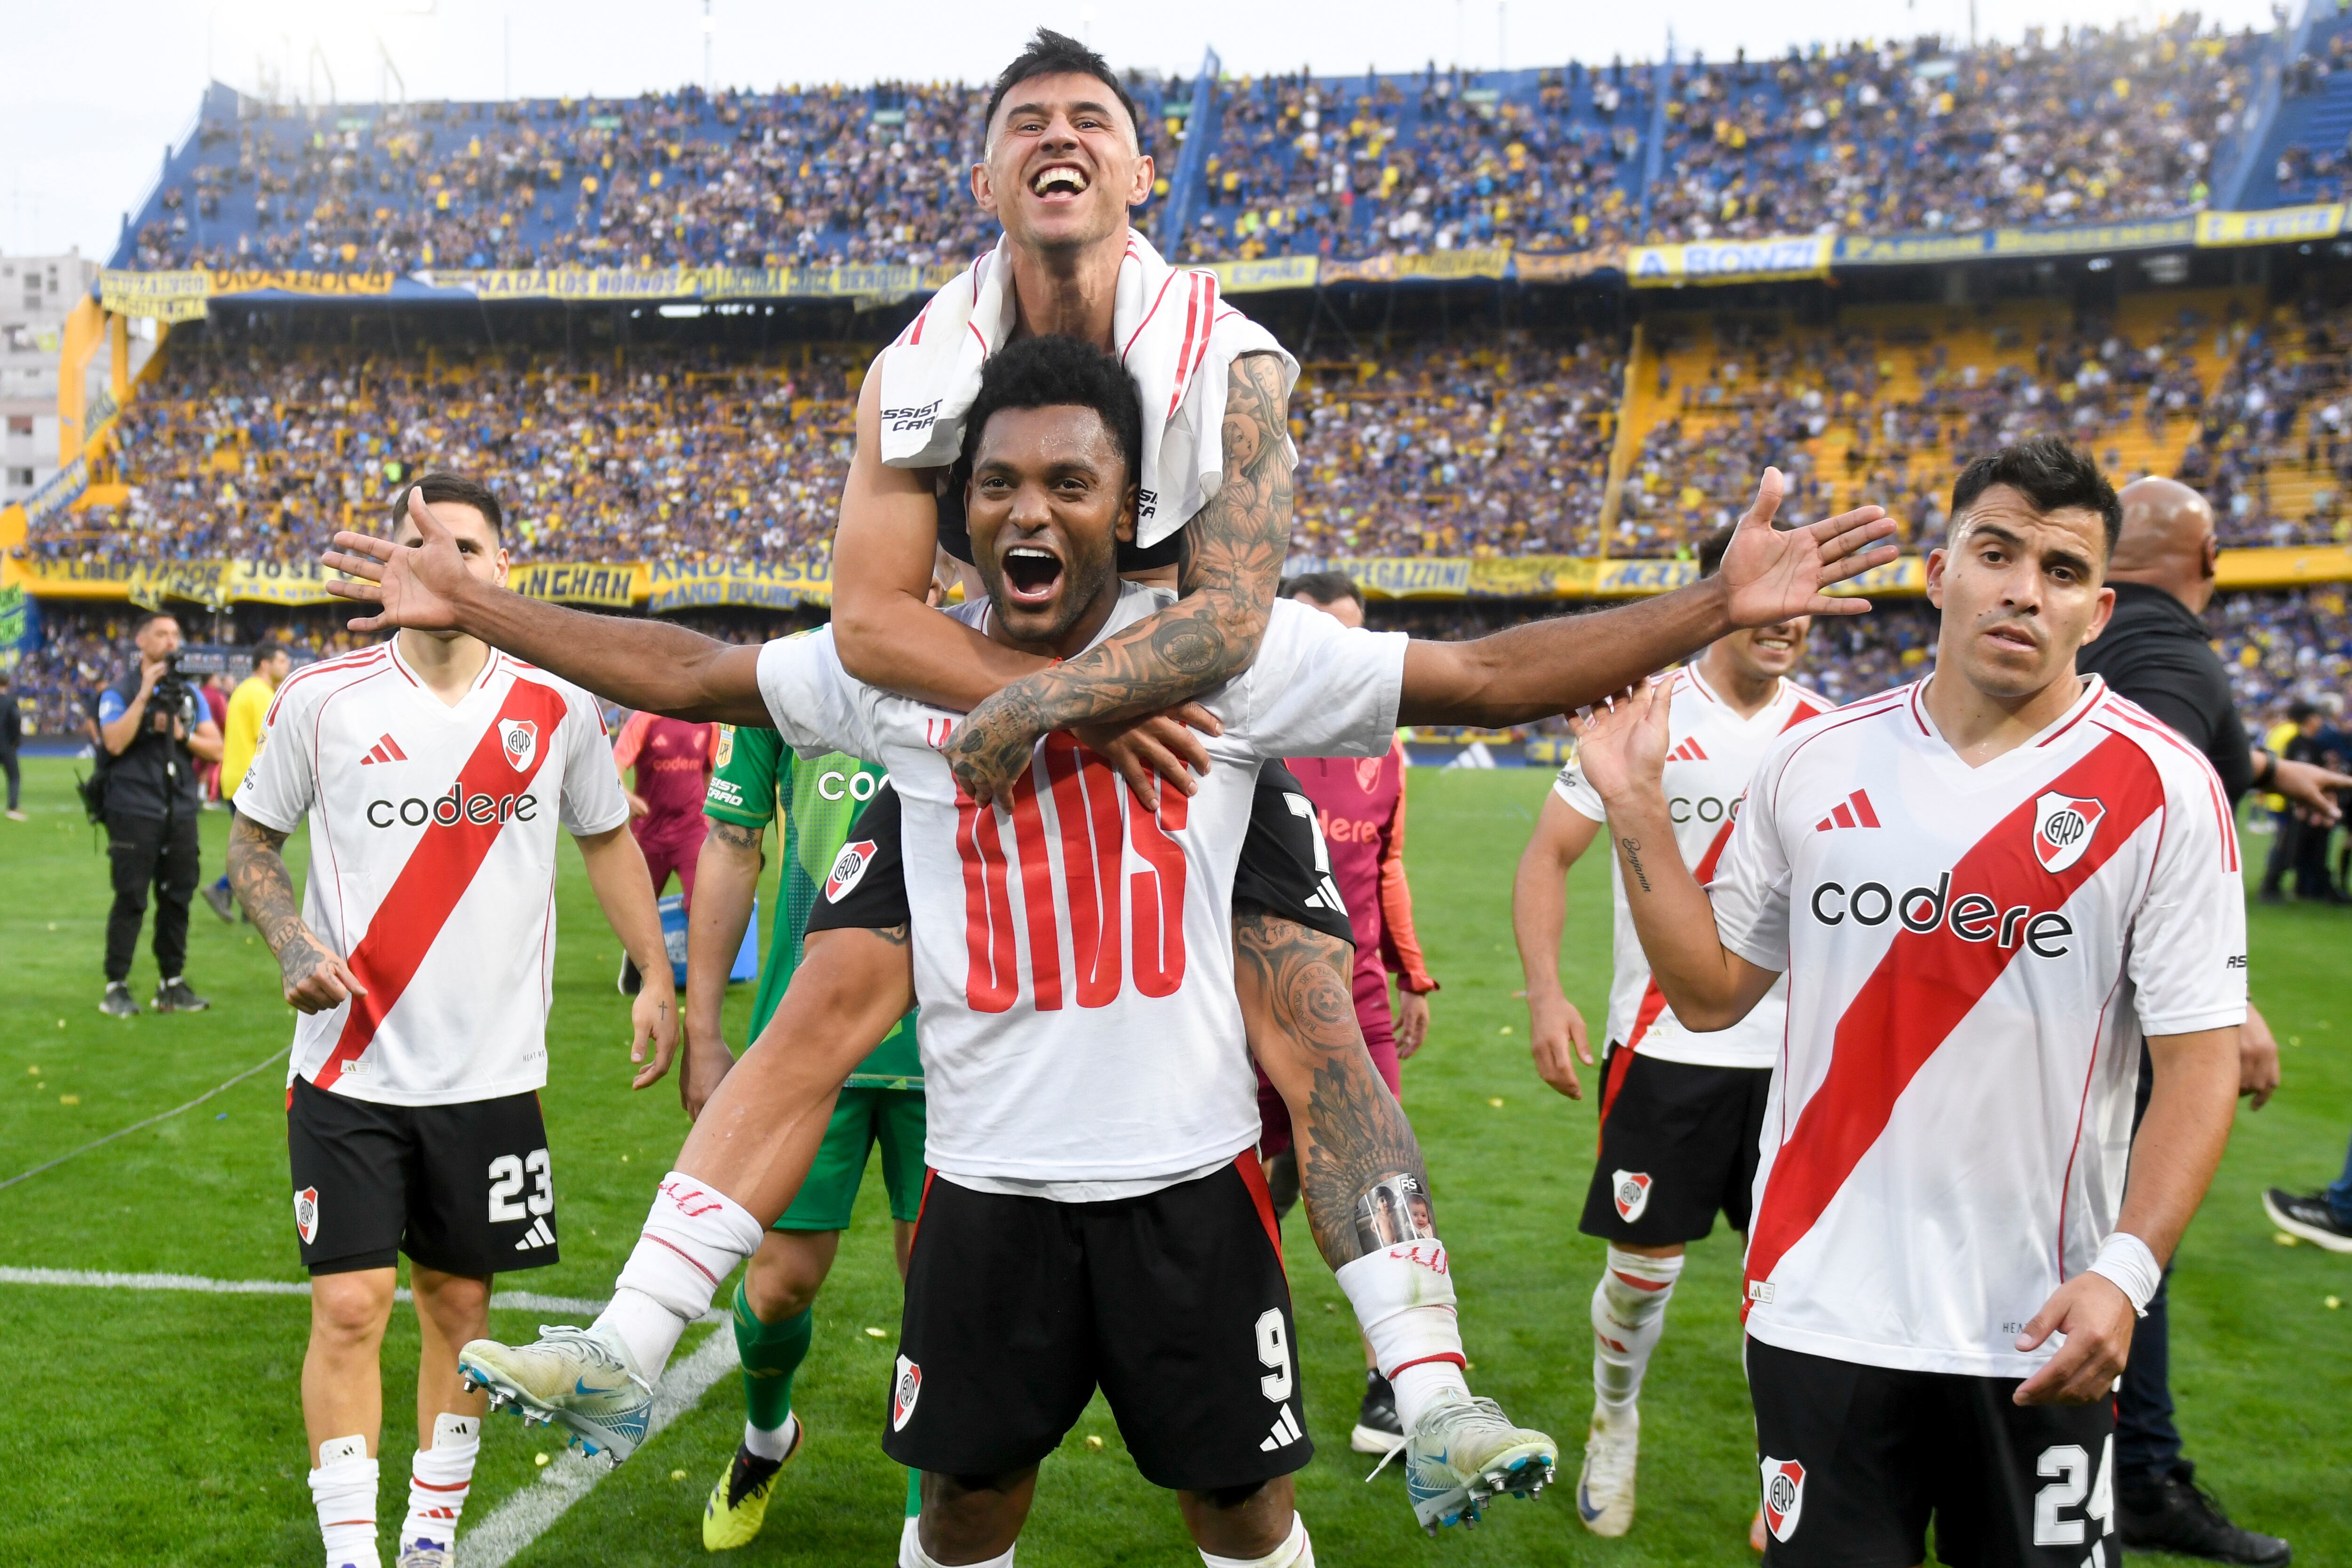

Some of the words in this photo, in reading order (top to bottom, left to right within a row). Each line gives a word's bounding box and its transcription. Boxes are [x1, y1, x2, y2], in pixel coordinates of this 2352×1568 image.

[881, 398, 943, 420] SSIST
[366, 781, 538, 828] codere
[1282, 792, 1331, 875] 7
[1810, 869, 2075, 961] codere
[488, 1147, 554, 1223] 23
[1254, 1306, 1293, 1403] 9
[2033, 1432, 2116, 1546] 24
